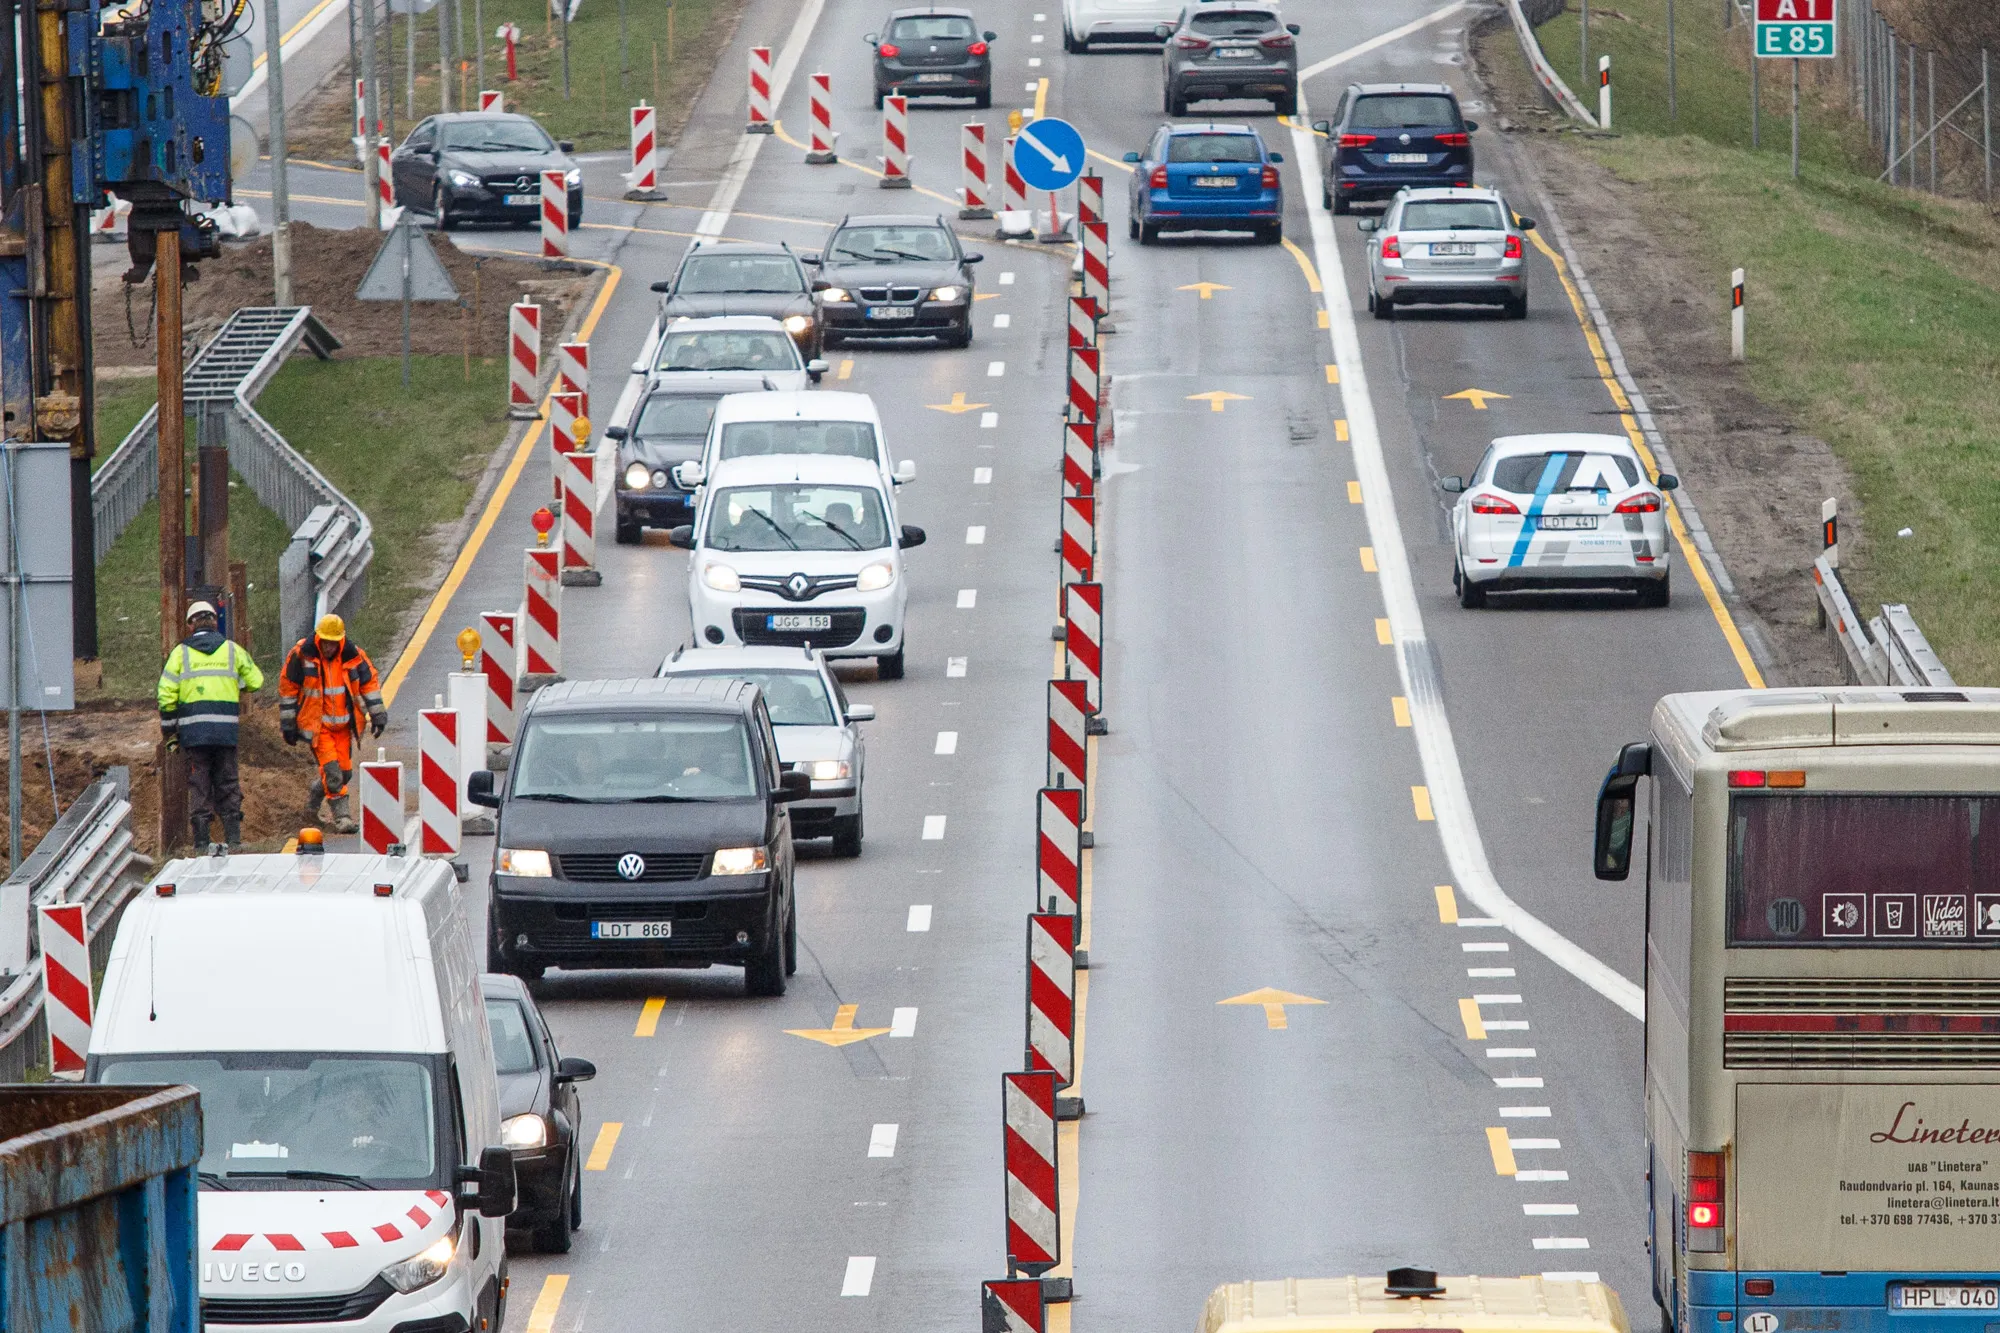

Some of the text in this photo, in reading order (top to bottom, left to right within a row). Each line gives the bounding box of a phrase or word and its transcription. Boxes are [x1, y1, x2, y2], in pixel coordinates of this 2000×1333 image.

[1776, 0, 1816, 19] A1
[1544, 517, 1594, 527] LDT 441
[774, 616, 829, 627] JGG 158
[1926, 895, 1964, 923] Vidéo
[1772, 900, 1800, 934] 100
[600, 923, 669, 937] LDT 866
[1925, 920, 1964, 932] TEMPE
[1870, 1101, 2000, 1144] Lineter
[1908, 1163, 1928, 1173] UAB
[1839, 1180, 1913, 1191] Raudondvario
[1915, 1180, 1929, 1194] pl.
[1887, 1196, 2000, 1210] linetera@linetera.lt
[1893, 1213, 1913, 1225] 698
[1957, 1213, 1988, 1225] +370
[203, 1262, 307, 1283] IVECO
[1904, 1288, 1996, 1307] HPL 040
[1752, 1315, 1772, 1333] LT
